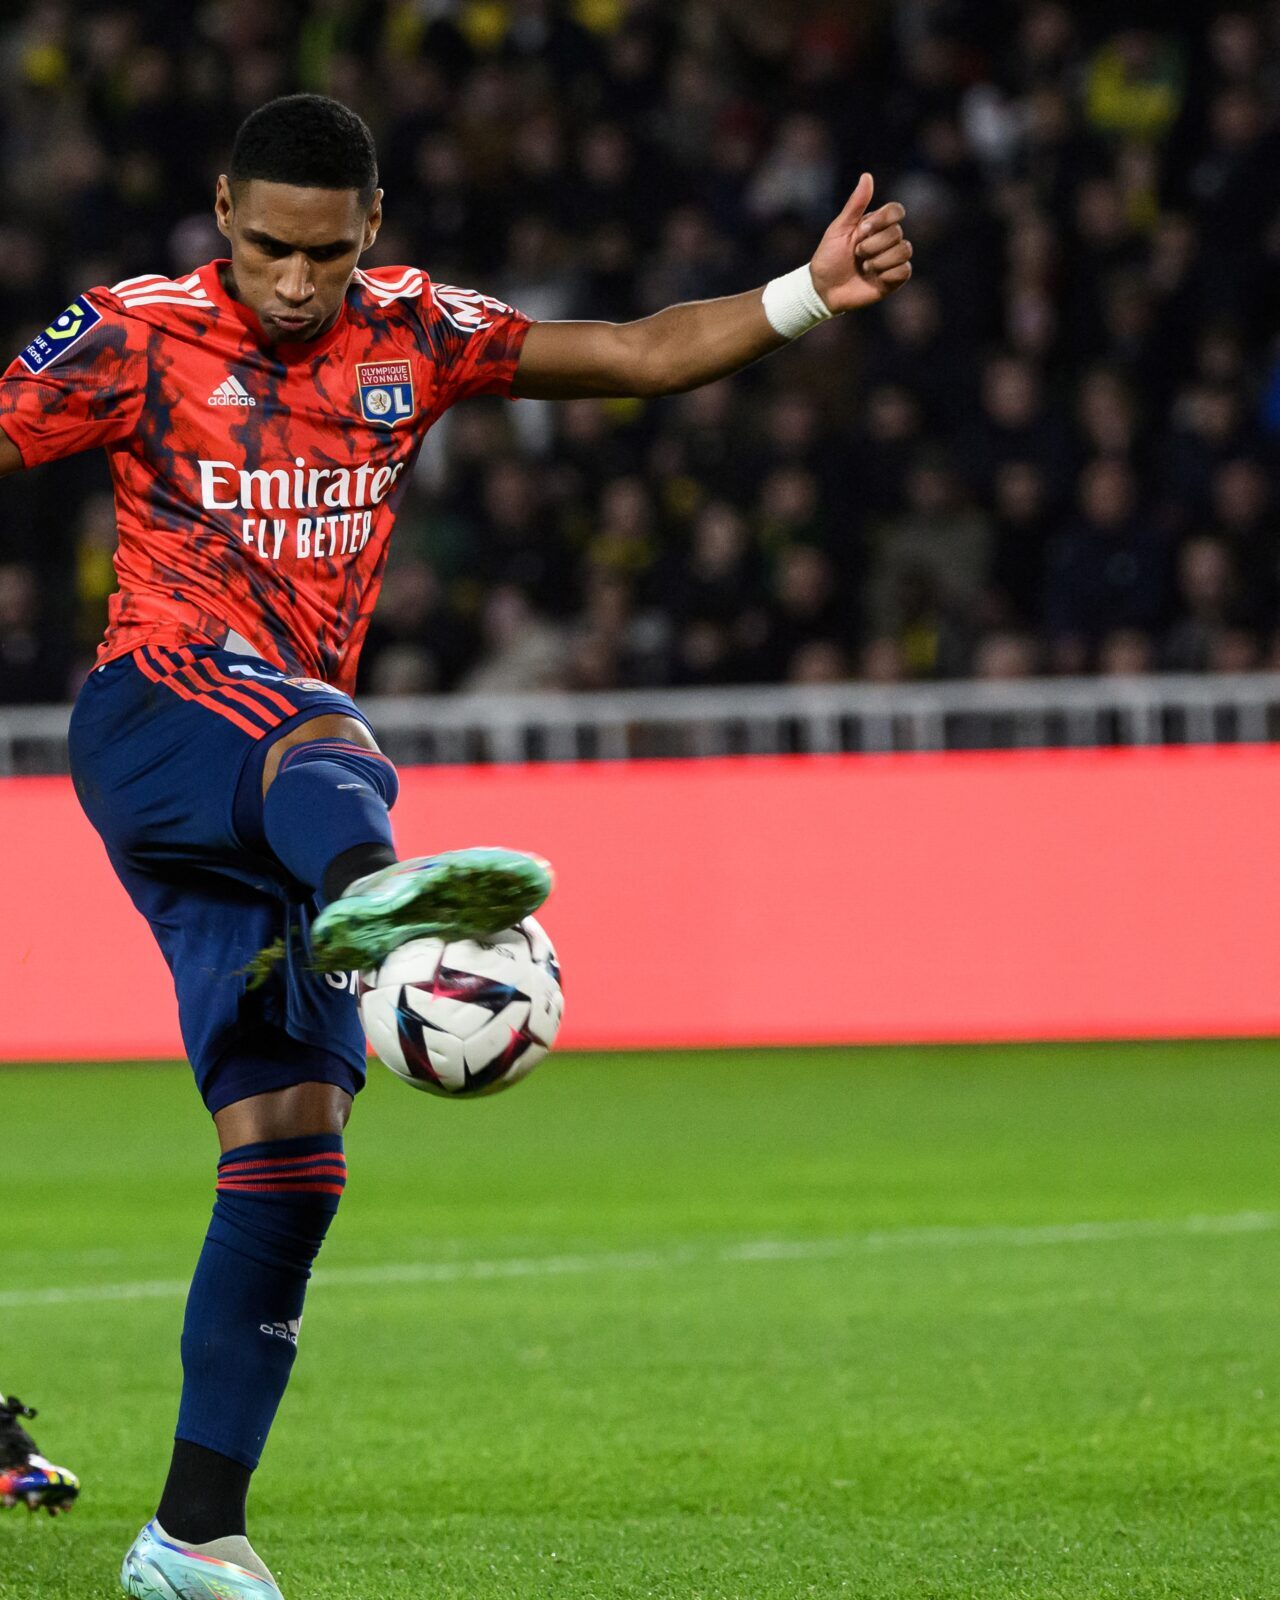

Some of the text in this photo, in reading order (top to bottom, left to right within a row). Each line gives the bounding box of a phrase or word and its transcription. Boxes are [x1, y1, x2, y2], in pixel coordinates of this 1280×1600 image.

[361, 365, 408, 377] OLYMPIQUE
[362, 373, 409, 385] LYONNAIS
[207, 394, 257, 407] adidas
[197, 456, 404, 510] Emirates
[242, 510, 372, 560] FLY BETTER
